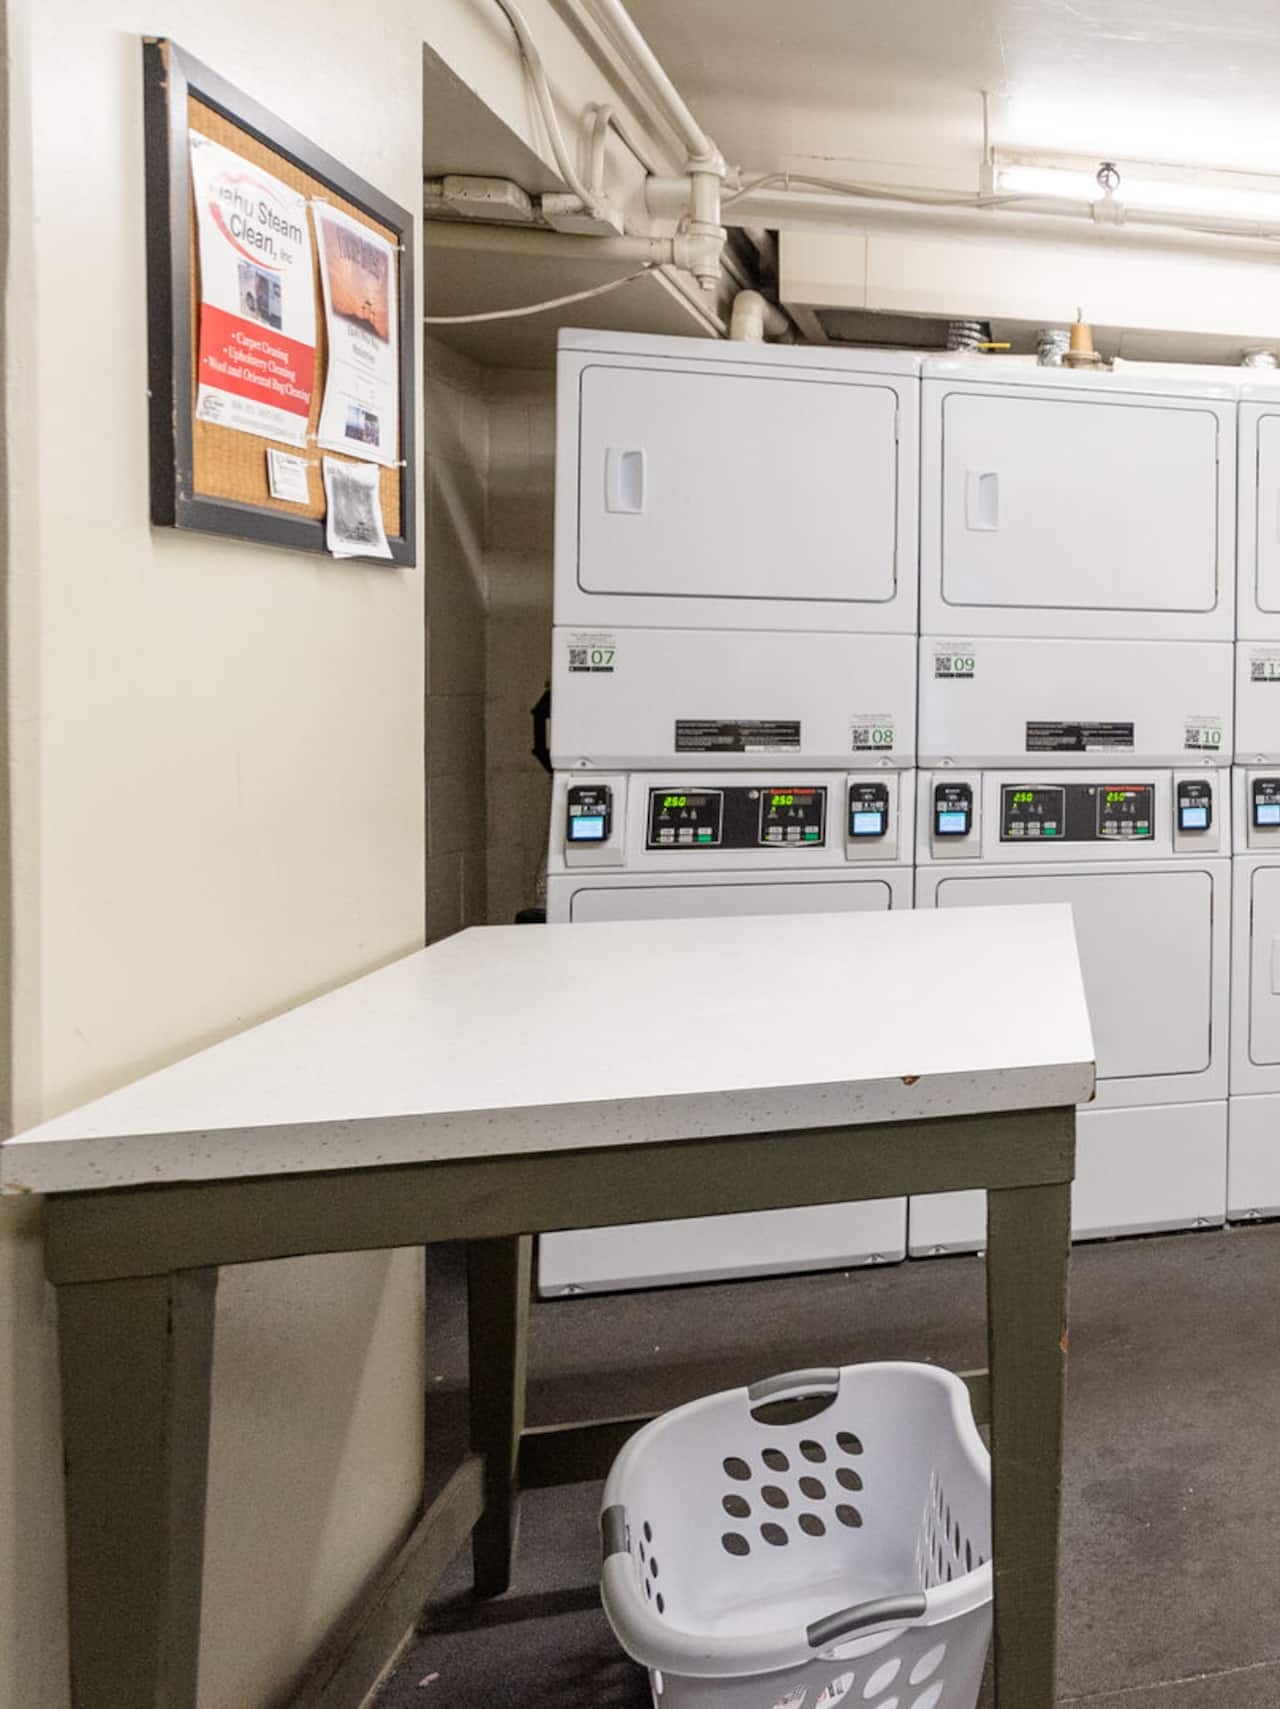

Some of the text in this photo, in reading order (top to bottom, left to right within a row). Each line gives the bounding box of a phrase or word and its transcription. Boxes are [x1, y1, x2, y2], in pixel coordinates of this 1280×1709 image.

[258, 202, 304, 245] Steam
[230, 214, 278, 260] Clean,
[591, 650, 615, 665] 07
[954, 657, 975, 672] 09
[872, 729, 894, 744] 08
[1203, 730, 1222, 744] 10
[663, 796, 688, 808] 250
